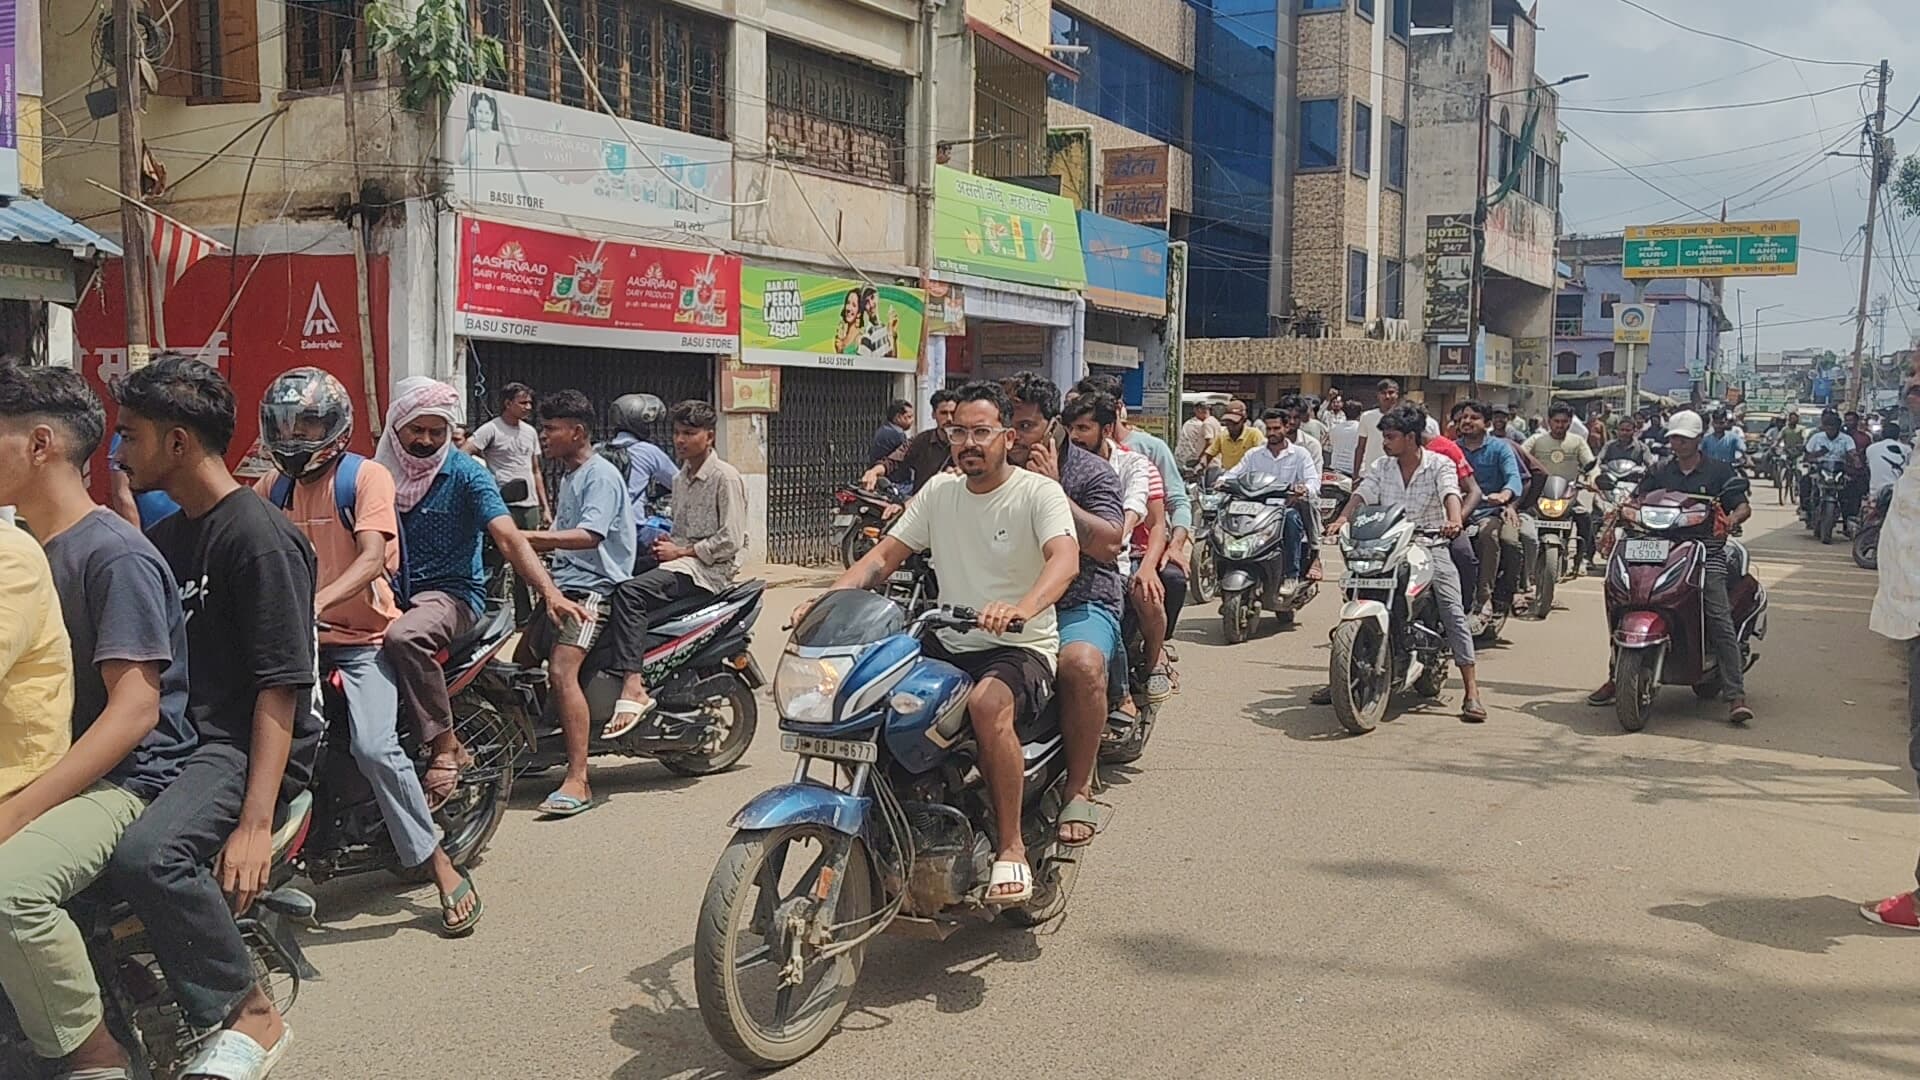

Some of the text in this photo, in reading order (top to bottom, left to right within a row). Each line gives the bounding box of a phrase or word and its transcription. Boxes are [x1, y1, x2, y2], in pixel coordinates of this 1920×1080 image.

[489, 191, 545, 209] BASU STORE
[1428, 228, 1470, 238] HOTEL
[1685, 249, 1734, 257] CHANDWA
[1749, 247, 1788, 255] RANCHI
[472, 253, 549, 276] AASHIRVAAD
[472, 267, 544, 287] DAIRY PRODUCTS
[626, 276, 678, 290] AASHIRVAAD
[625, 288, 674, 299] DAIRY PRODUCTS
[764, 290, 801, 307] PEERA
[763, 305, 804, 322] LAHORI
[465, 318, 538, 336] BASU STORE
[768, 321, 799, 338] ZEERA
[681, 337, 733, 349] BASU STORE
[818, 356, 854, 367] BASU STORE
